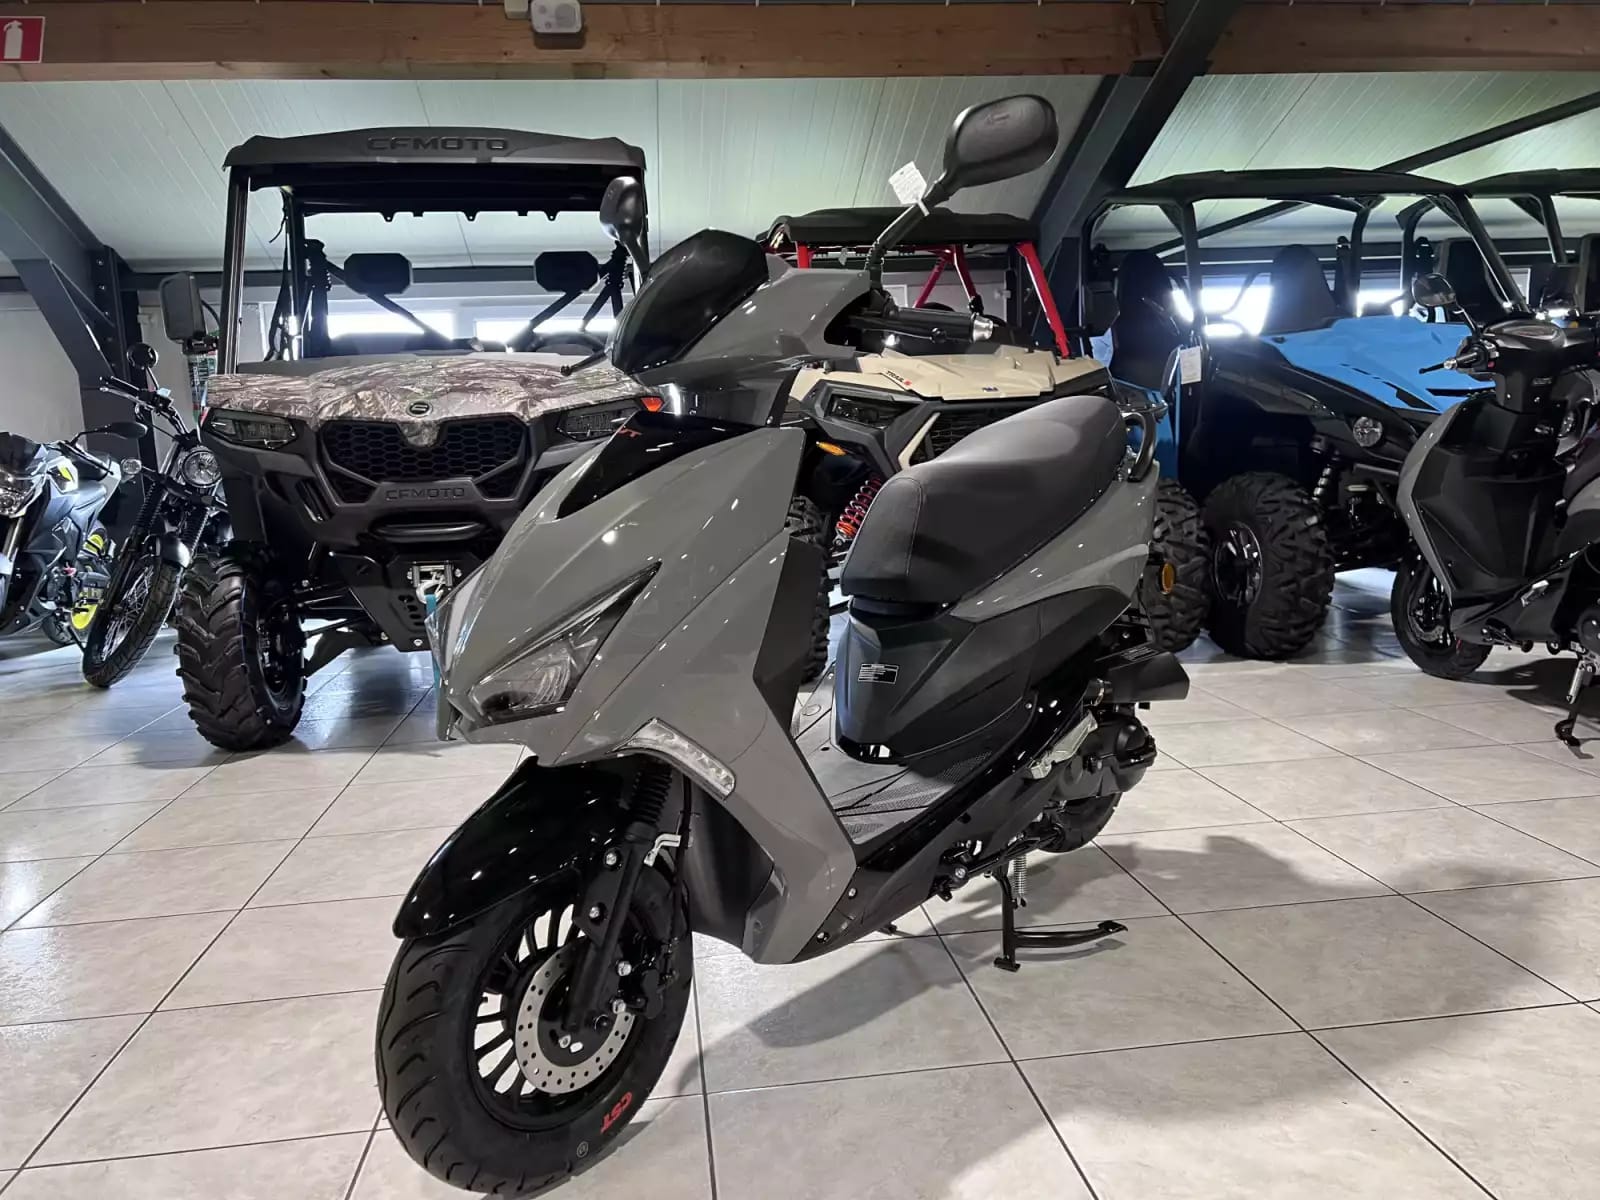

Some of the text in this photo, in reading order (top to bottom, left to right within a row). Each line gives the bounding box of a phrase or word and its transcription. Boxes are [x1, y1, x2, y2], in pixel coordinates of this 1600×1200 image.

[367, 137, 508, 150] CFMOTO
[386, 487, 464, 499] CFMOTO
[601, 1092, 632, 1133] CST
